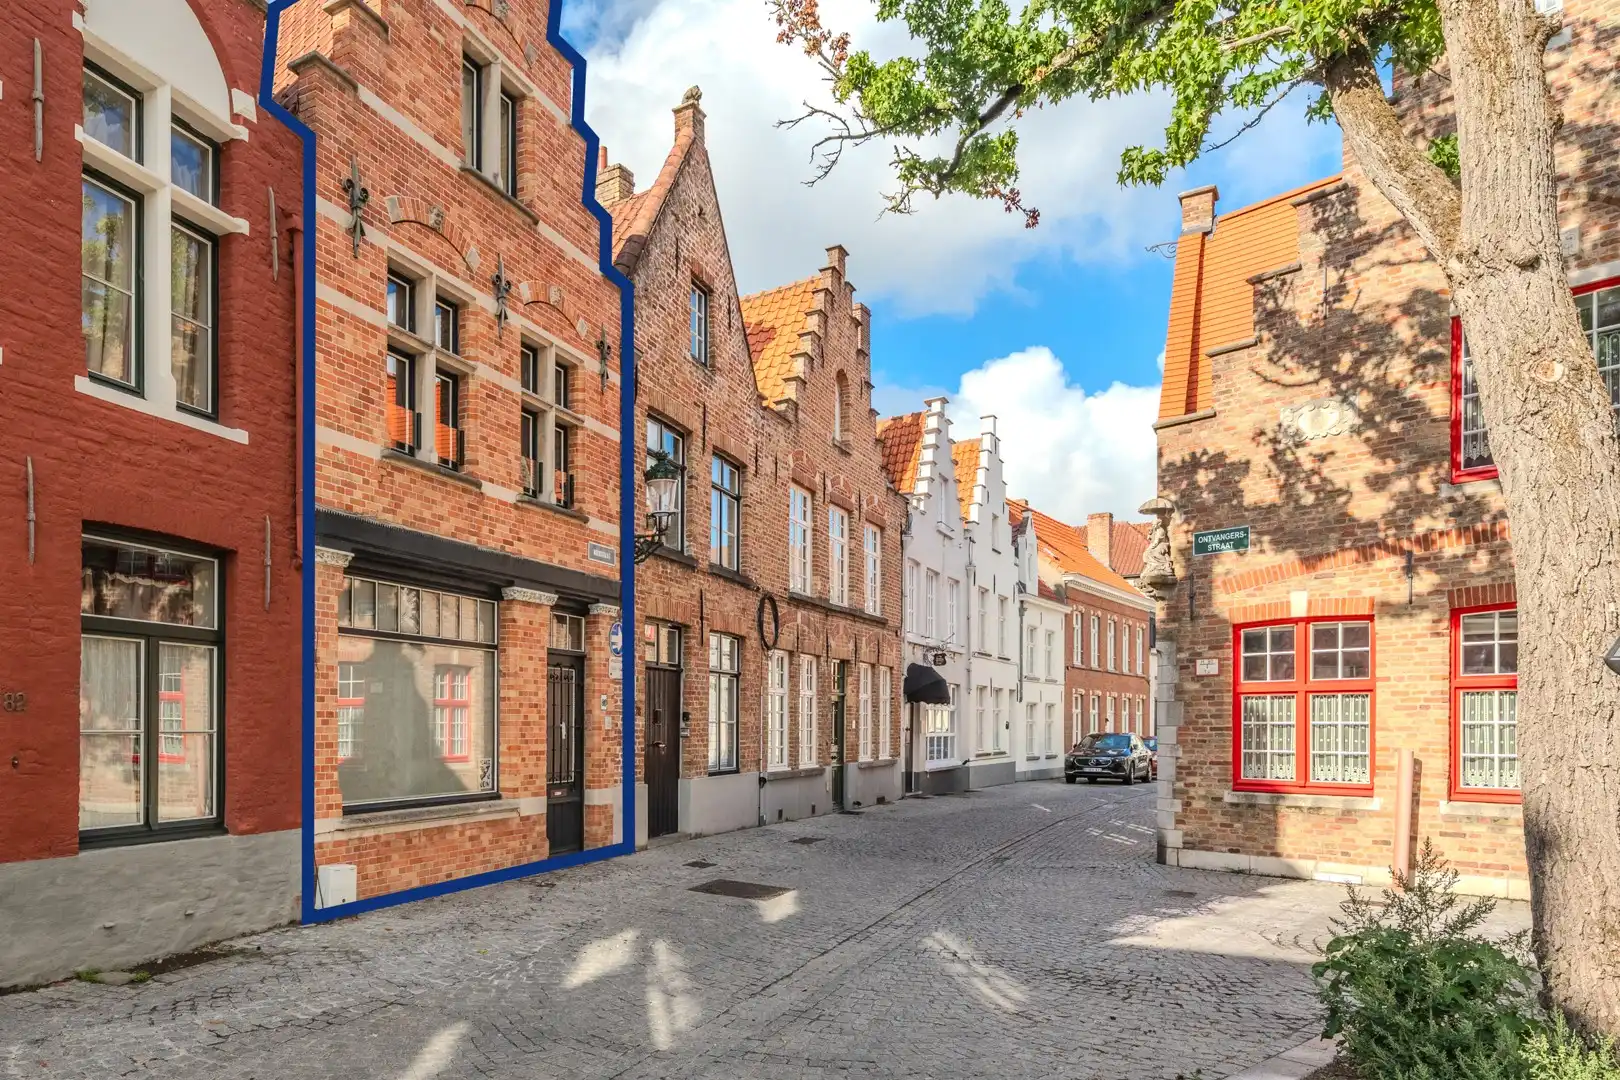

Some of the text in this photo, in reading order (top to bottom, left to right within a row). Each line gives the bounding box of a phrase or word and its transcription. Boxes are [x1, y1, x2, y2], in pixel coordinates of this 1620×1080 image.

[1198, 531, 1247, 543] ONTVANGERS-
[1207, 542, 1234, 551] STRAAT
[3, 692, 25, 711] 82
